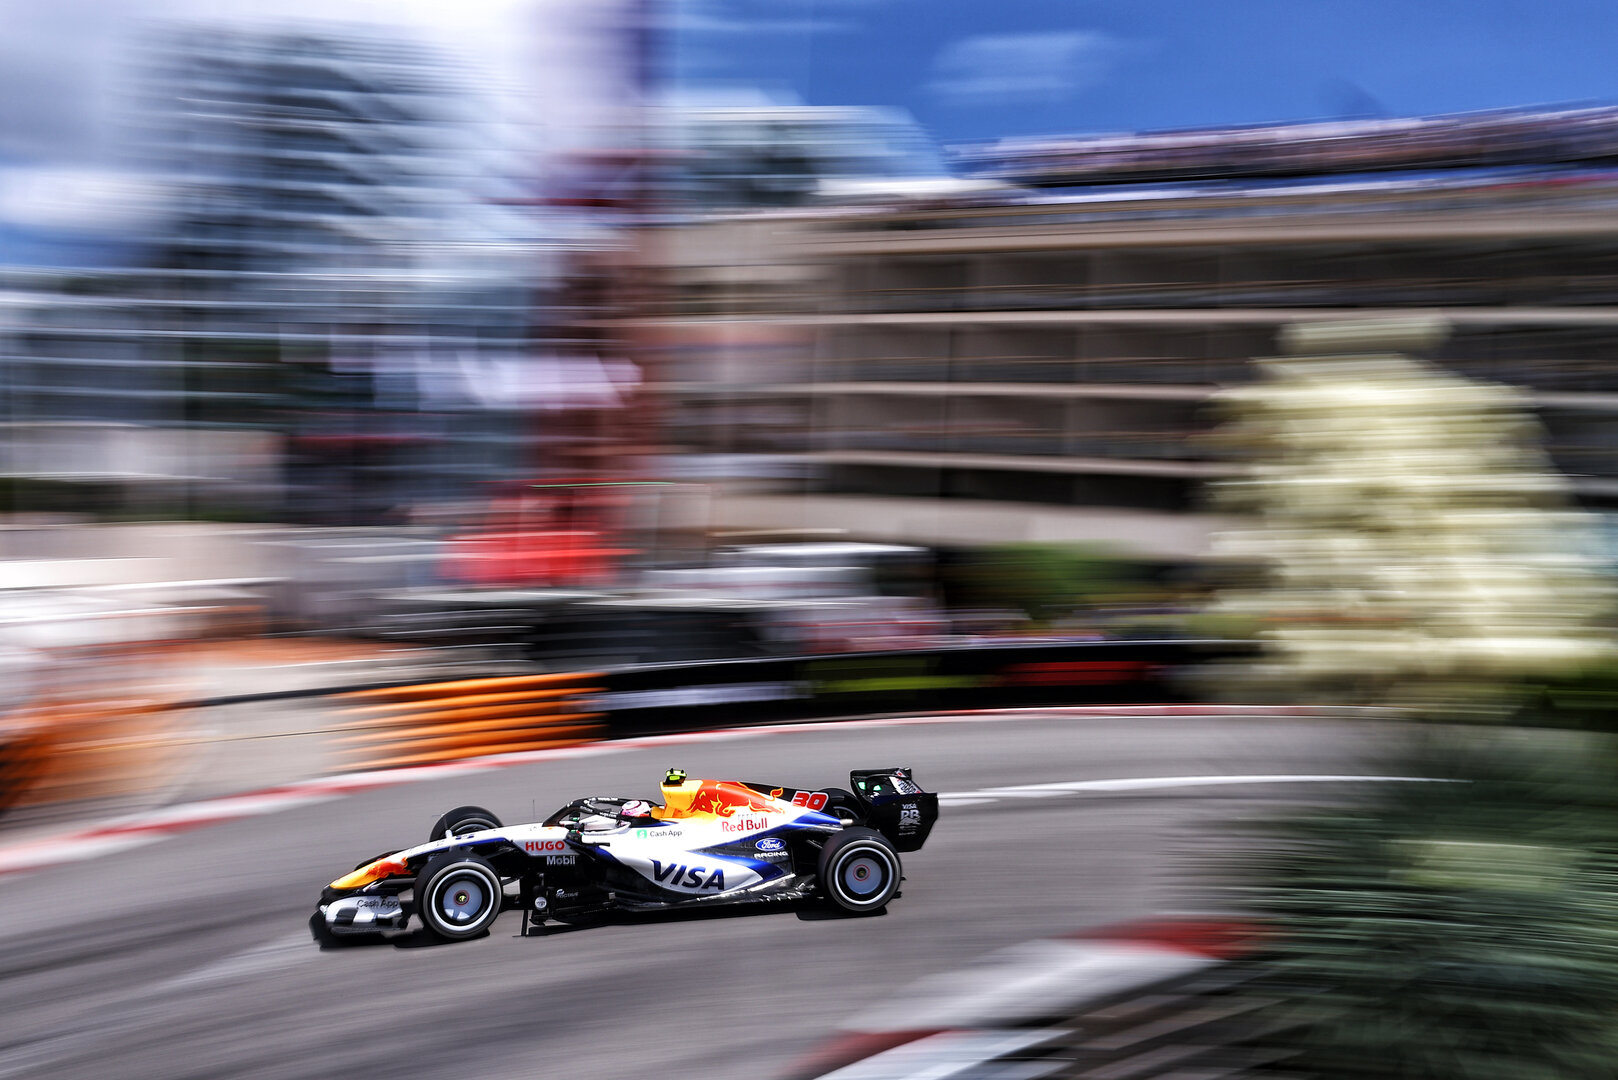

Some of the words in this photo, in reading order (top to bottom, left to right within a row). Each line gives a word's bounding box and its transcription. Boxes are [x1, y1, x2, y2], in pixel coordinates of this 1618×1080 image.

[791, 791, 828, 811] 30
[722, 820, 744, 832] Red
[746, 818, 768, 830] Bull
[525, 841, 565, 851] HUGO
[761, 840, 781, 849] Ford
[754, 851, 789, 859] RACING
[546, 856, 576, 865] Mobil
[651, 860, 725, 890] VISA
[357, 899, 379, 908] Cash
[380, 900, 399, 908] App
